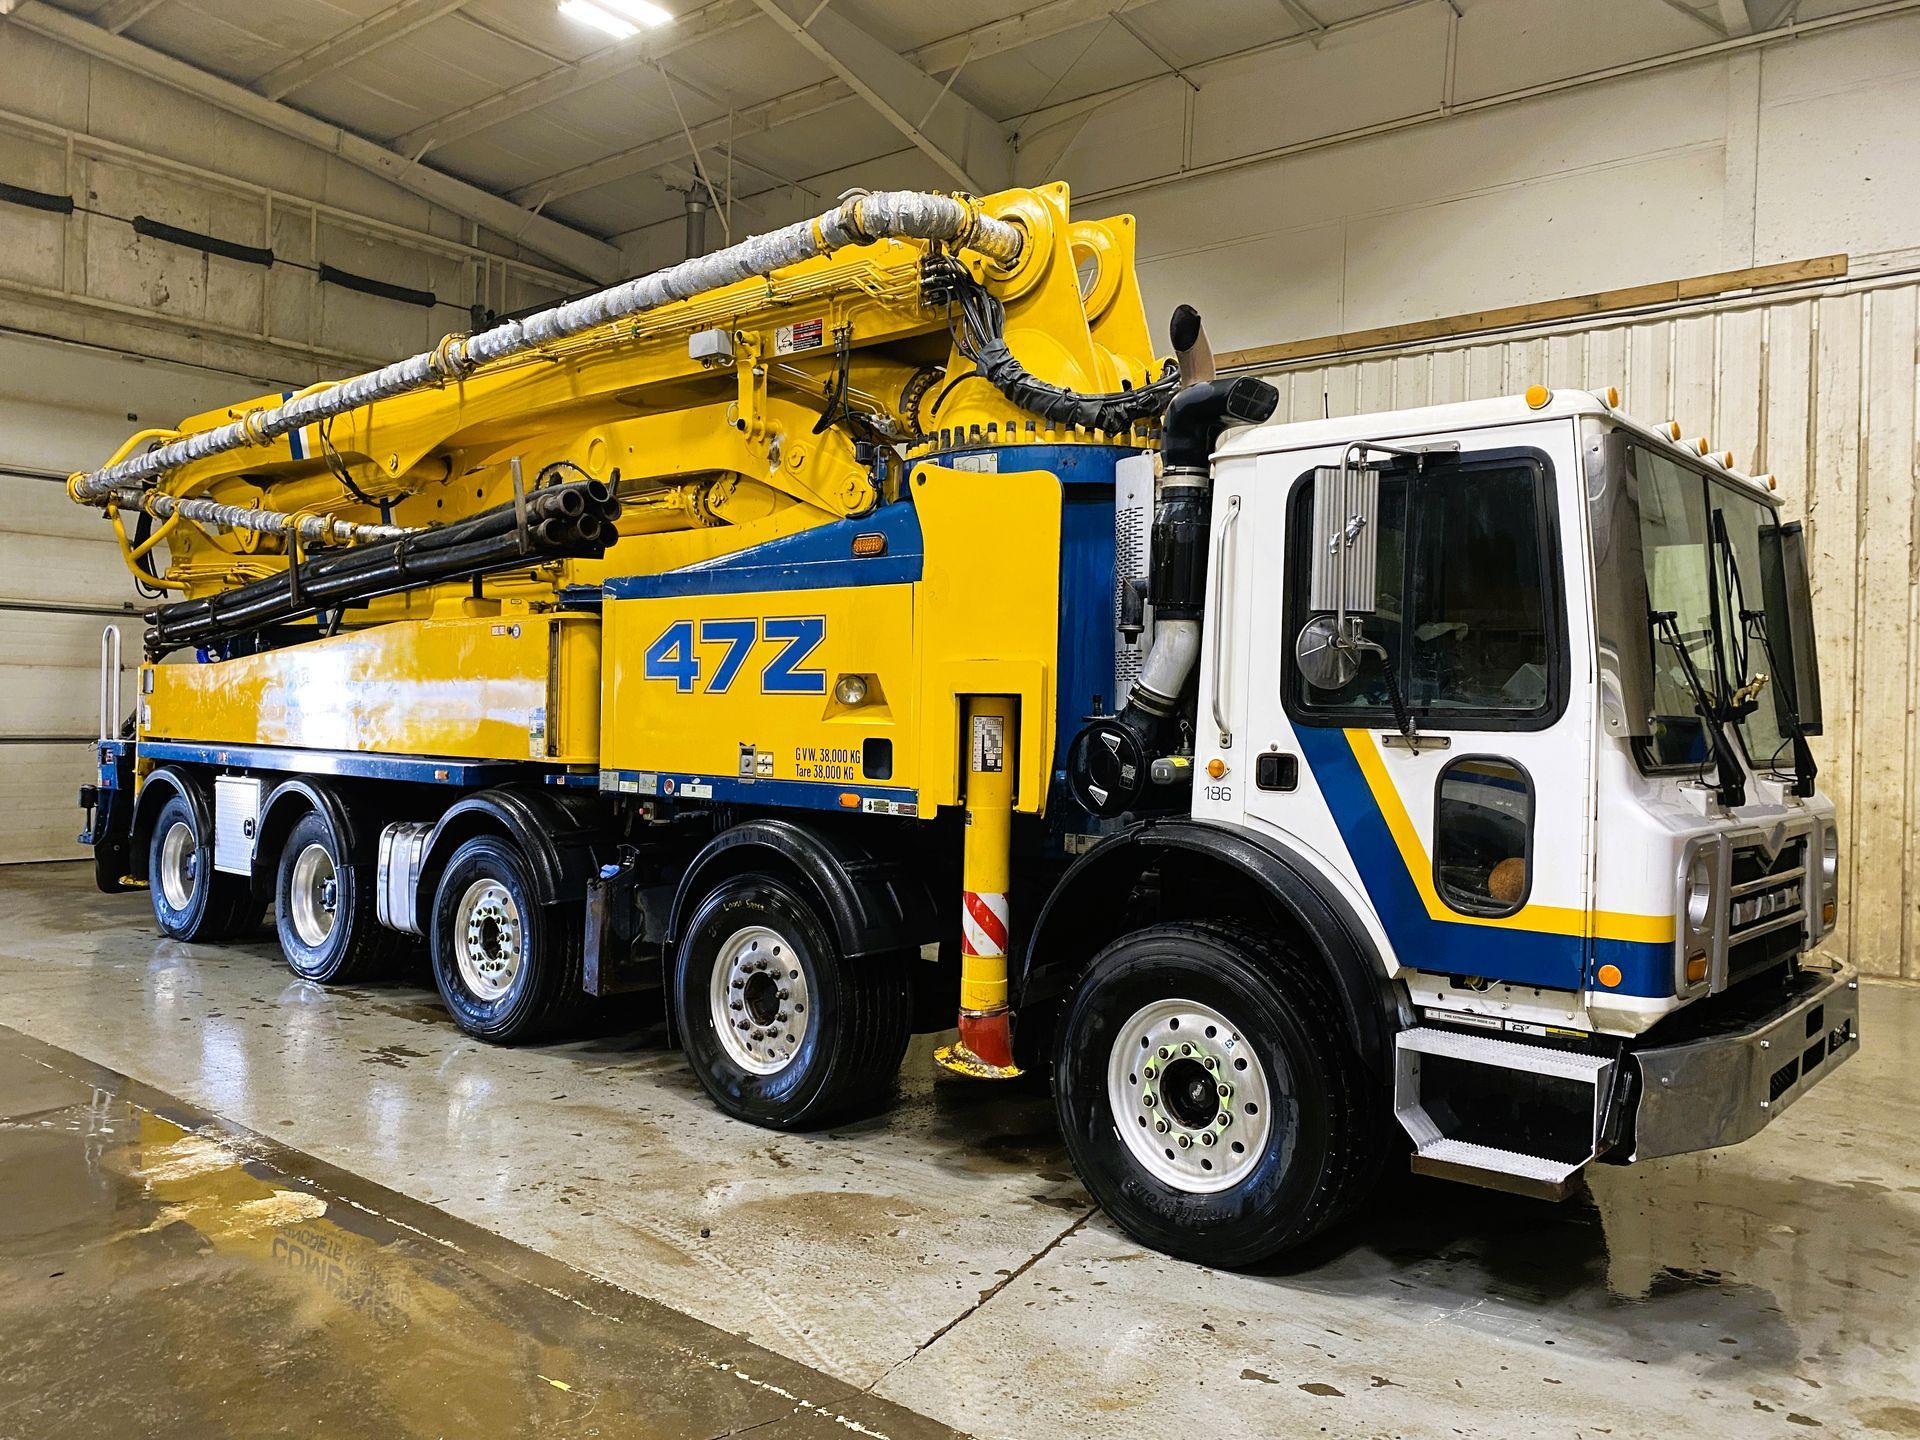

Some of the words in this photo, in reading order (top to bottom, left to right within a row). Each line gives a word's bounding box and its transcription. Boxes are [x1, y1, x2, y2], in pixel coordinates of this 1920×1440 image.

[643, 614, 827, 696] 47Z
[819, 748, 848, 765] 38,000
[850, 749, 861, 764] KG
[795, 763, 812, 778] Tare
[813, 764, 841, 780] 38,000
[843, 765, 854, 781] KG
[1204, 785, 1232, 802] 186
